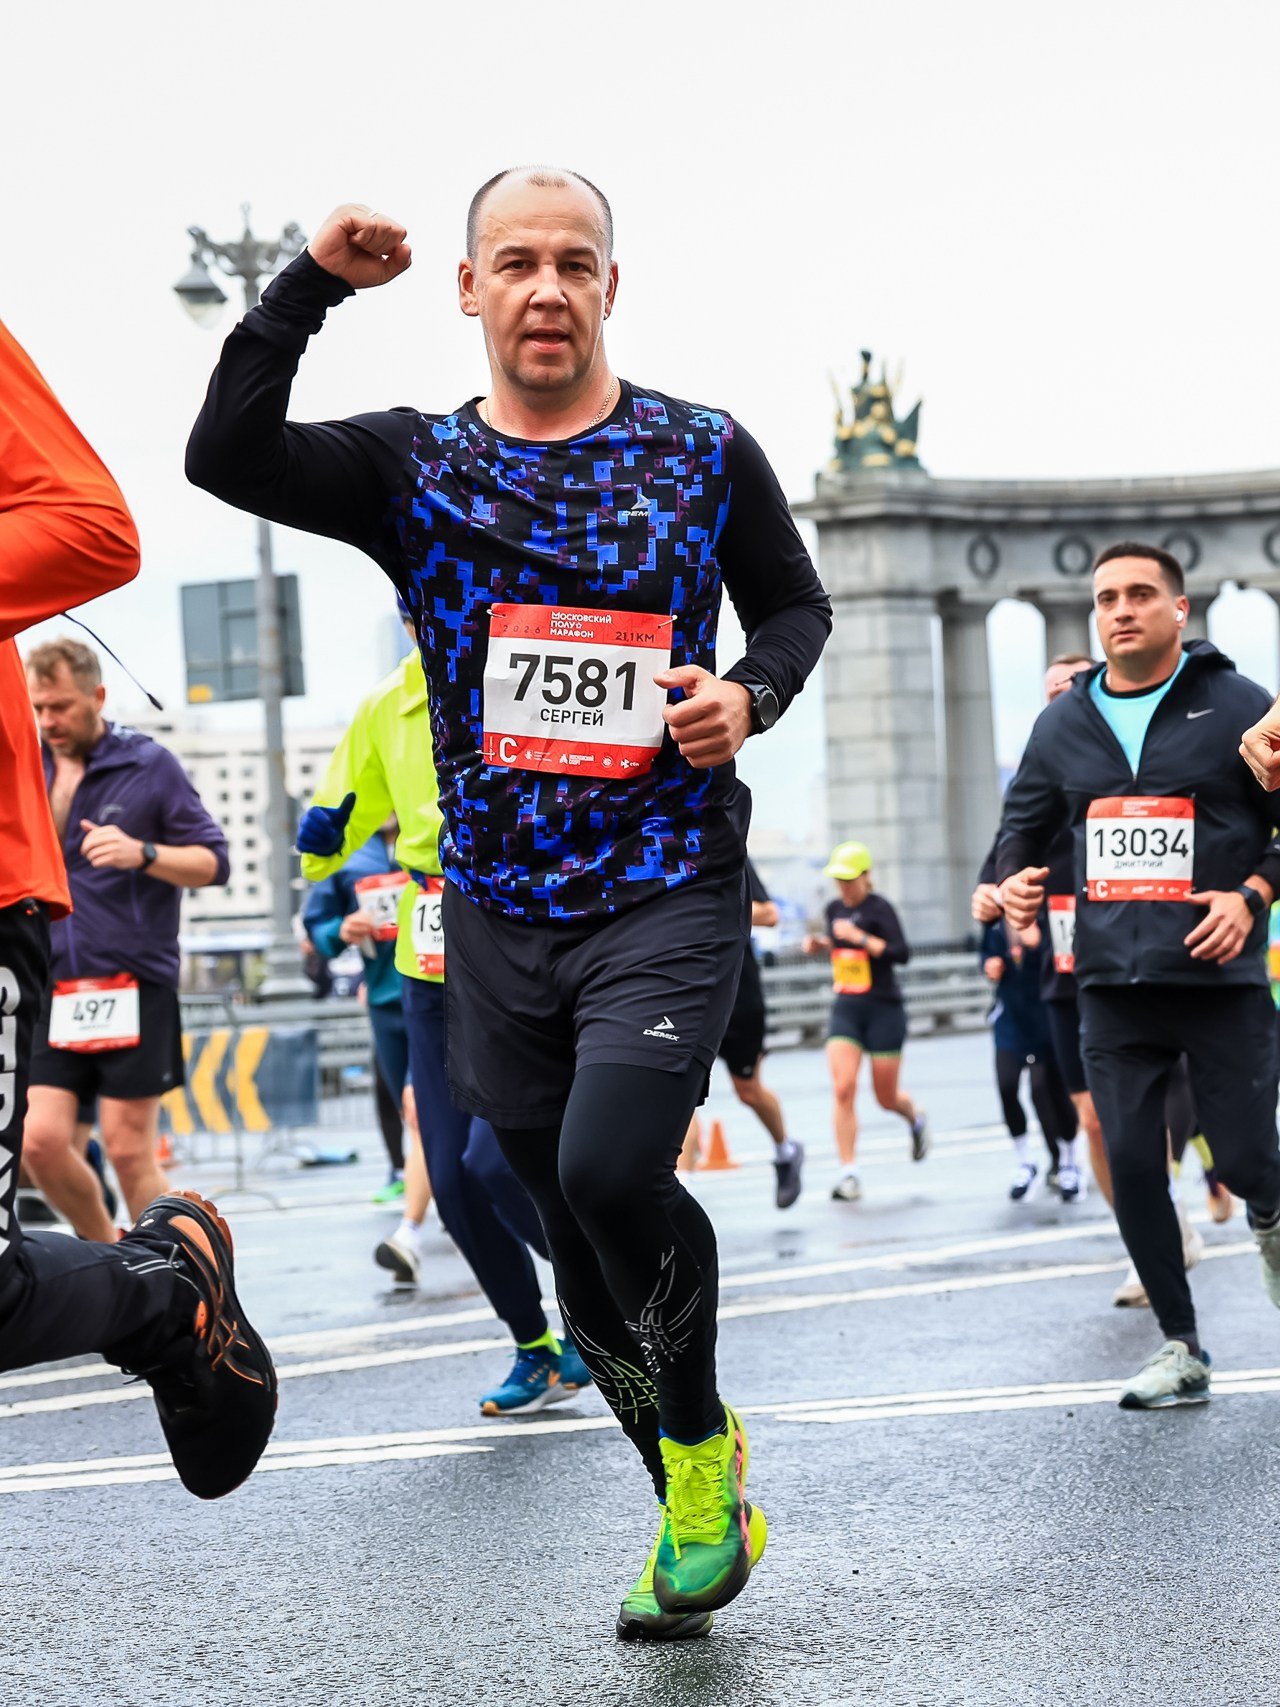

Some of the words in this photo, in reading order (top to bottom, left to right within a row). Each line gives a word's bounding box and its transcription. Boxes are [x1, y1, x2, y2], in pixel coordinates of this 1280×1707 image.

[551, 611, 612, 624] МОСКОВСКИЙ
[501, 623, 542, 635] 2026
[550, 621, 575, 629] ПОЛУ
[549, 628, 595, 639] МАРАФОН
[509, 652, 637, 712] 7581
[540, 708, 605, 727] СЕРГЕЙ
[1093, 828, 1189, 858] 13034
[72, 997, 117, 1024] 497
[642, 1028, 681, 1042] DEMIX
